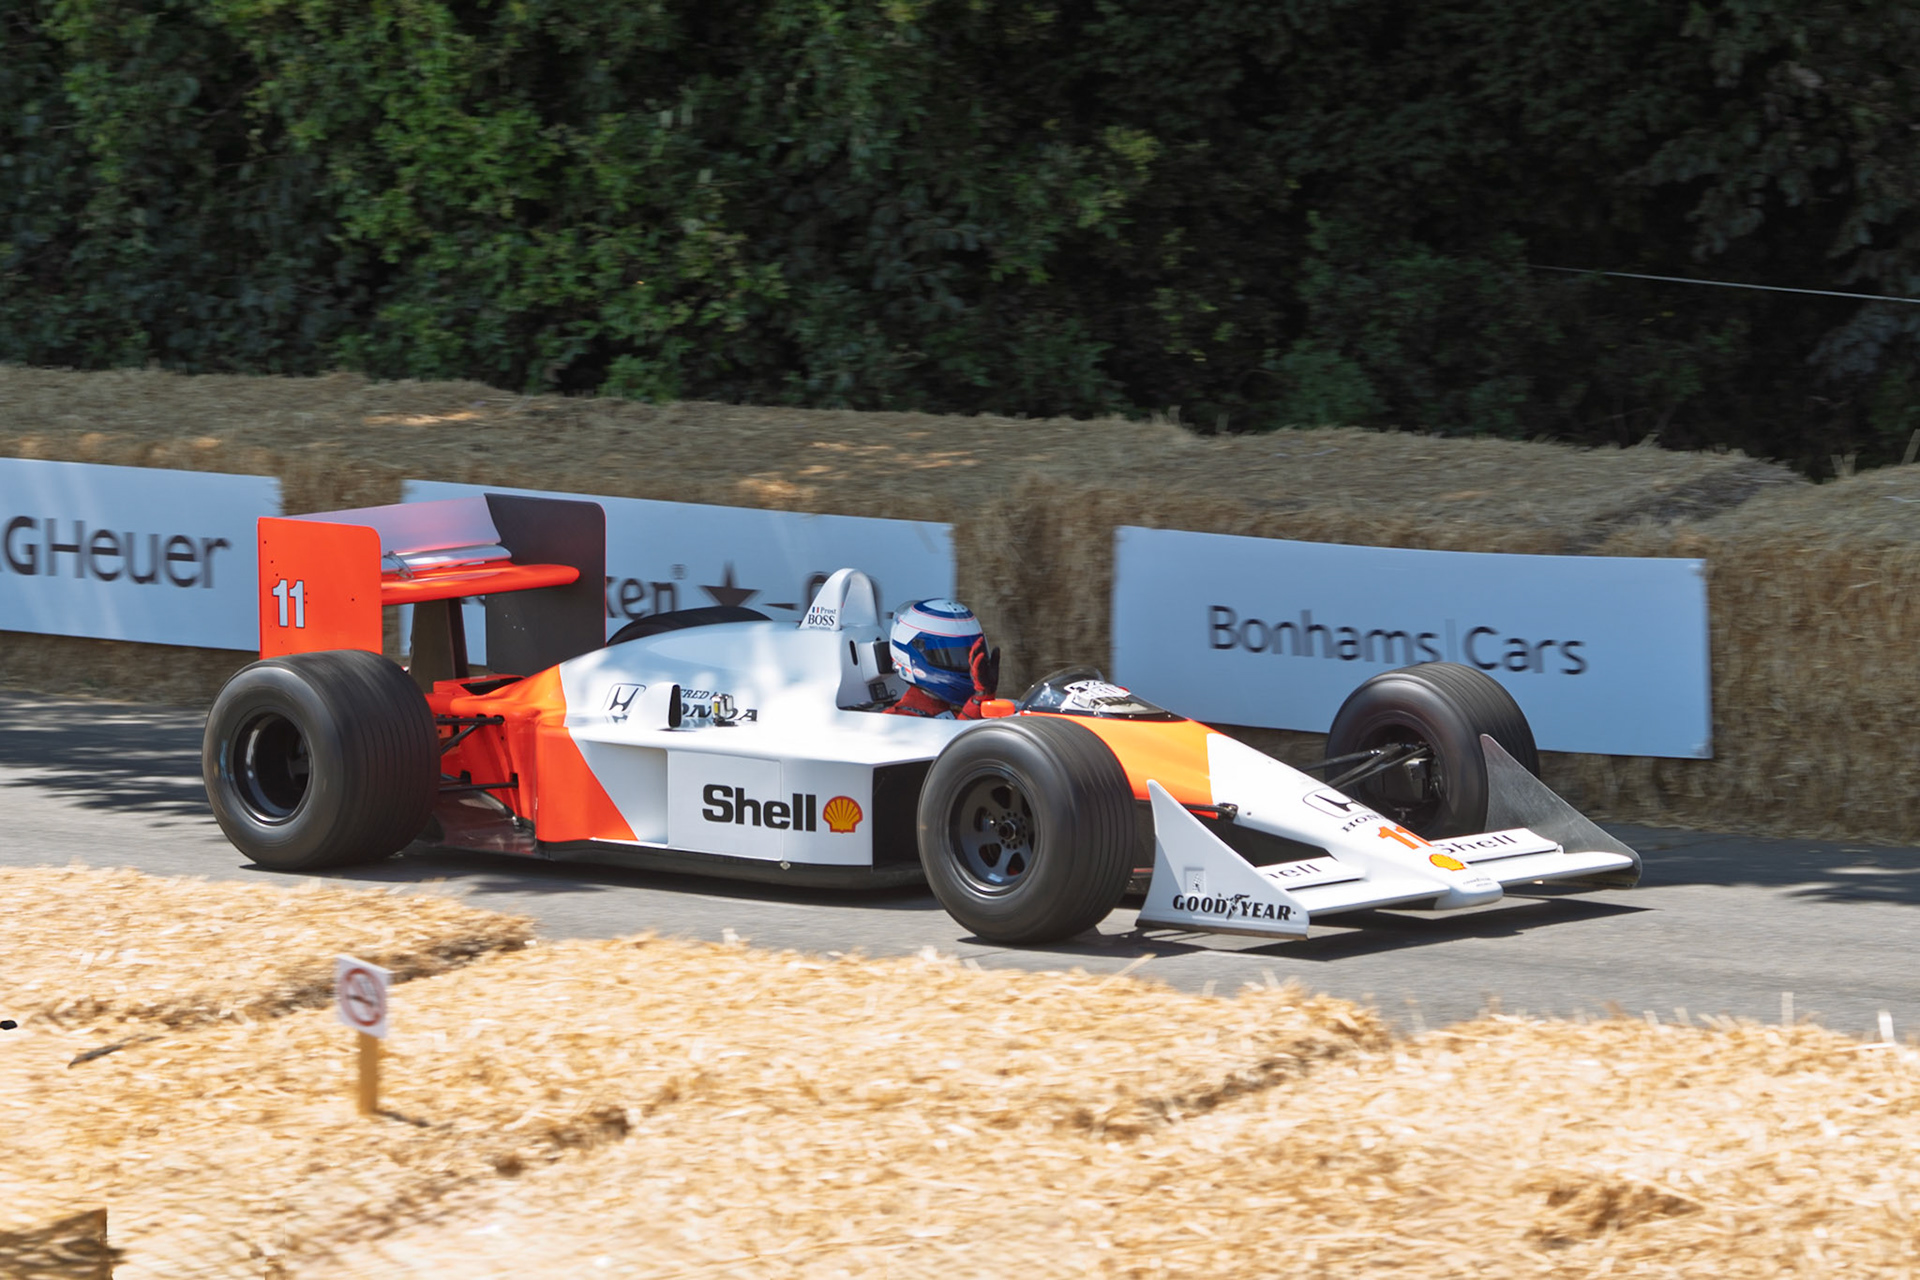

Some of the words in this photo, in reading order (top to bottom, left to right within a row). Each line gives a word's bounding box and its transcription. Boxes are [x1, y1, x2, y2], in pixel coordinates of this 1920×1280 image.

[0, 515, 232, 589] GHeuer
[272, 578, 305, 629] 11
[807, 613, 836, 627] BOSS
[1208, 604, 1441, 666] Bonhams
[1463, 625, 1588, 675] Cars
[702, 783, 817, 832] Shell
[1342, 813, 1386, 833] HON
[1377, 825, 1433, 850] 11
[1433, 834, 1518, 855] Shell
[1172, 893, 1291, 921] GOODYEAR
